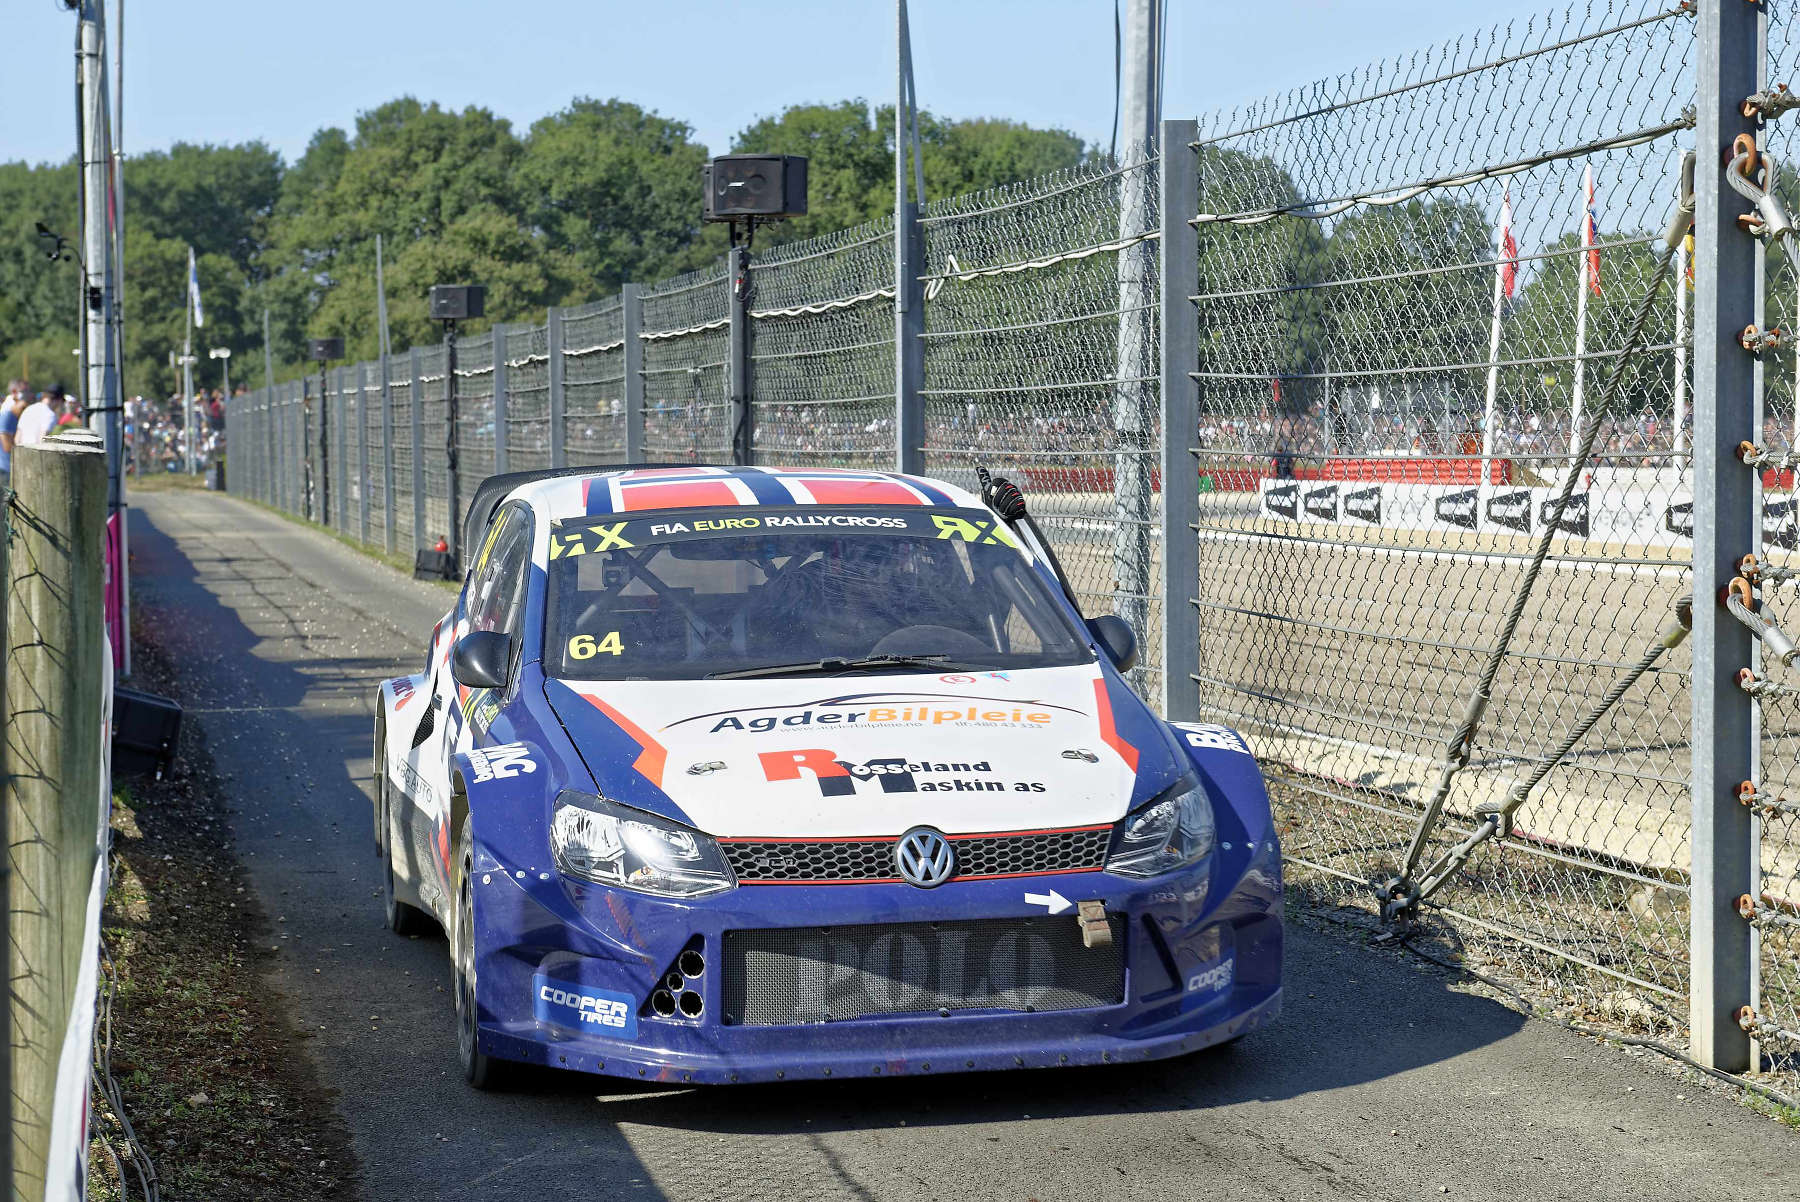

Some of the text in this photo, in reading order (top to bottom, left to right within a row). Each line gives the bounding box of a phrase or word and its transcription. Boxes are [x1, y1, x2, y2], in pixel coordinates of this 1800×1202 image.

[650, 515, 908, 536] FIA EURO RALLYCROSS
[568, 631, 625, 660] 64
[1014, 781, 1047, 794] as
[797, 930, 1057, 1018] POLO
[540, 985, 628, 1018] COOPER
[578, 1009, 627, 1028] TIRES
